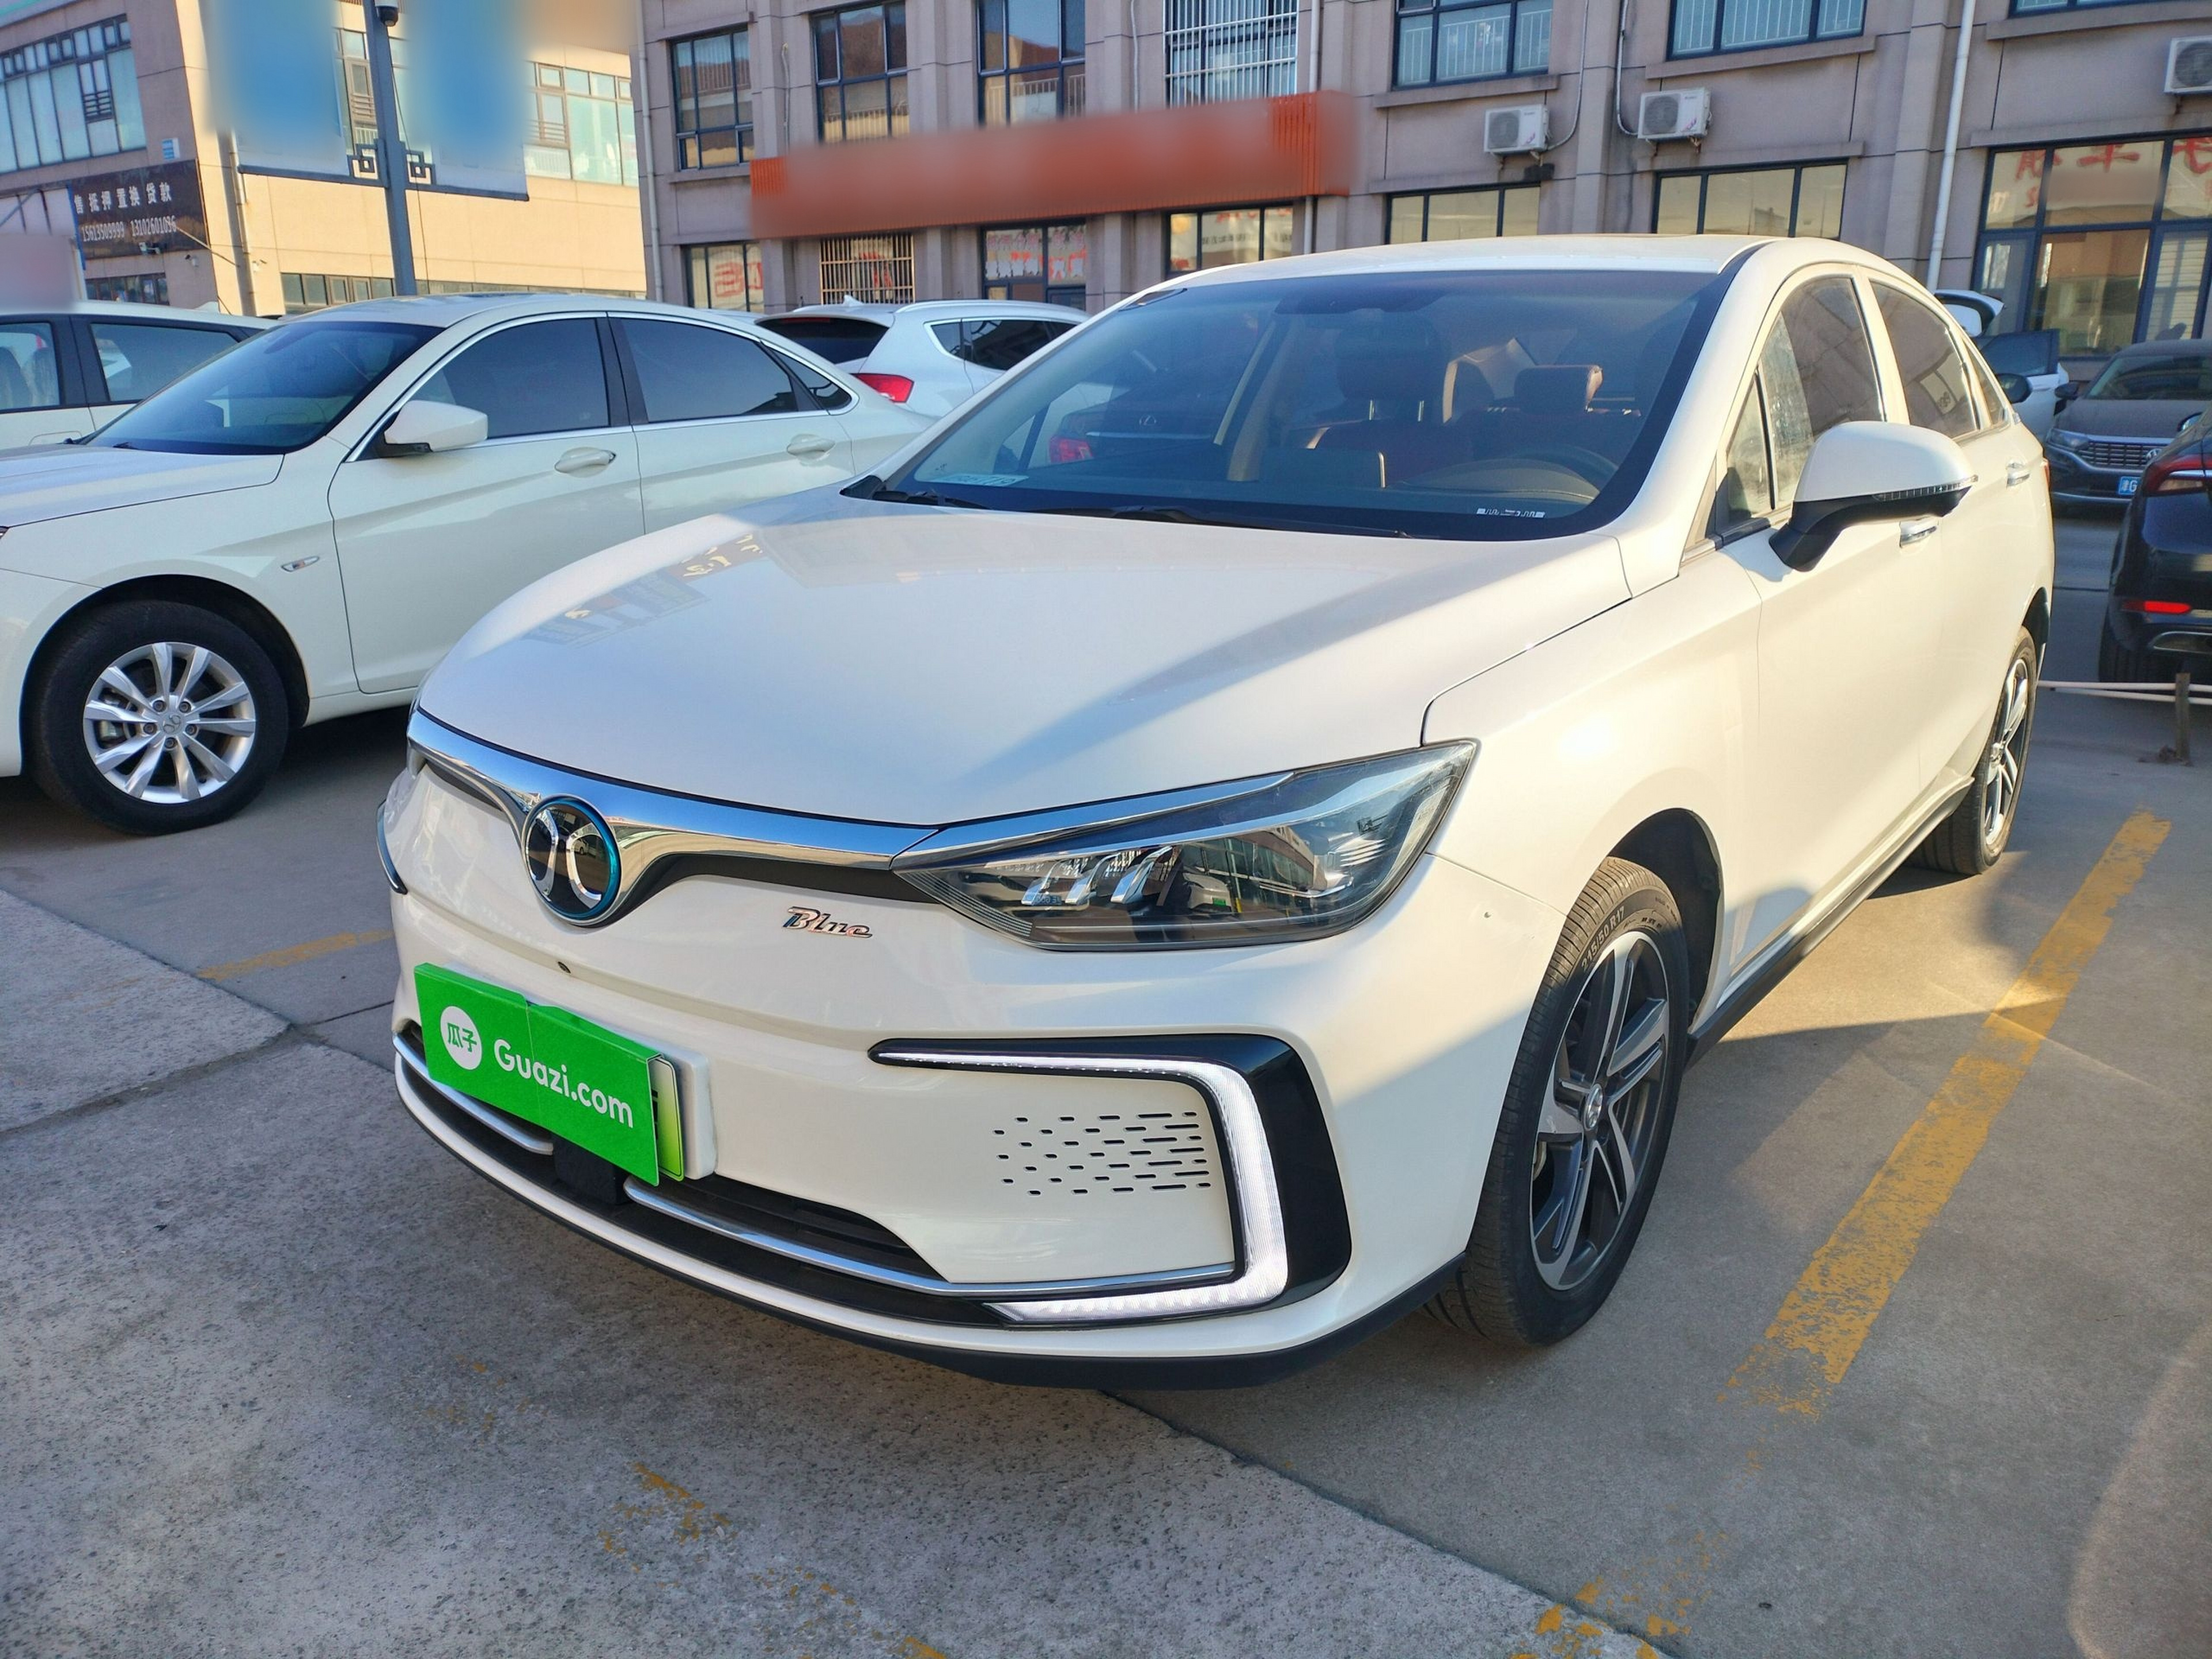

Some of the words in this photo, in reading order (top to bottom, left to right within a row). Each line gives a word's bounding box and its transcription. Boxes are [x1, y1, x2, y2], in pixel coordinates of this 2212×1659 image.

[1582, 924, 1609, 972] 215/50
[1609, 906, 1624, 930] R17
[446, 1022, 477, 1052] 瓜子
[494, 1039, 633, 1128] Guazi.com
